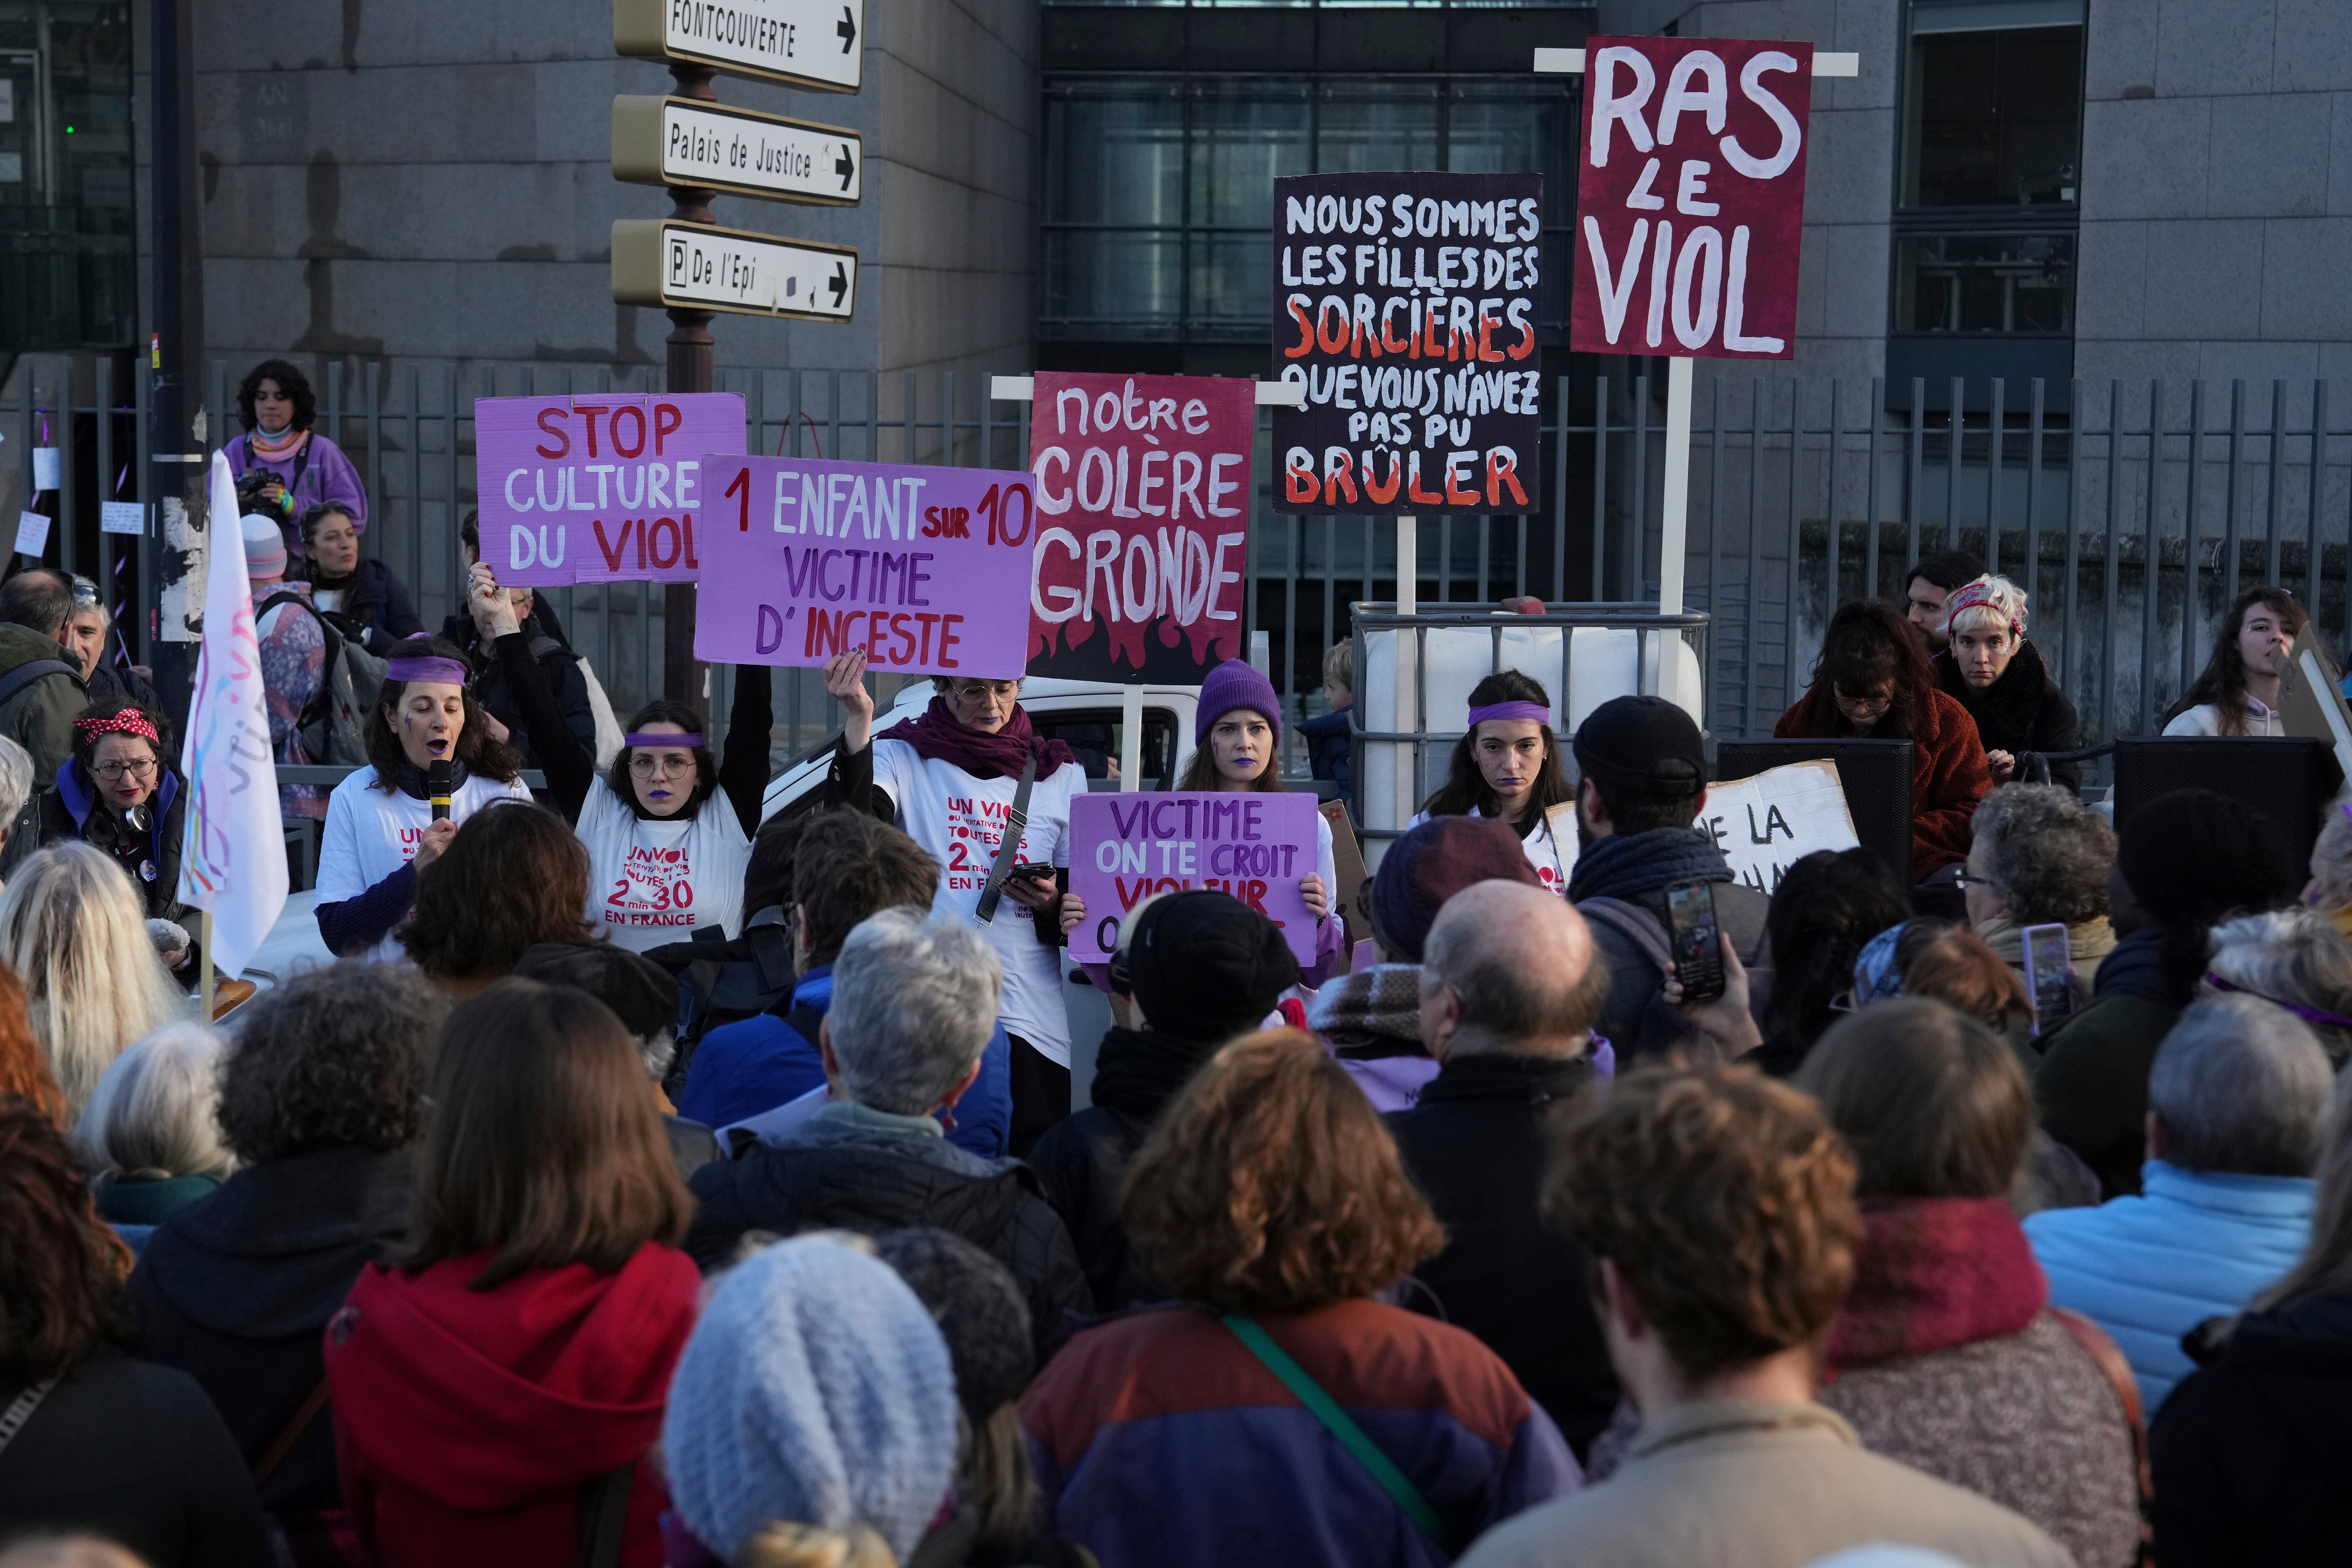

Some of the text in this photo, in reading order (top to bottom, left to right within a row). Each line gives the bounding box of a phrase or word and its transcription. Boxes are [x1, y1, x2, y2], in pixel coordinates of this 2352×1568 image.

[672, 0, 795, 58] FONTCOUVERTE
[1590, 46, 1801, 179] RAS
[670, 123, 811, 178] Palais de Justice
[1626, 158, 1720, 217] LE
[1287, 193, 1540, 243] NOUS SOMMES
[693, 249, 712, 283] De
[721, 253, 756, 298] l'Epi
[1282, 245, 1347, 286] LES
[1483, 246, 1539, 290] DES
[1583, 216, 1785, 354] VIOL
[1285, 287, 1535, 363] SORCIÈRES
[1281, 362, 1540, 417] QUE VOUS N'AVEZ
[535, 403, 682, 459] STOP
[1349, 411, 1471, 448] PAS PU
[505, 461, 700, 512] CULTURE
[1032, 433, 1243, 520] COLÈRE
[1286, 443, 1529, 506] BRÛLER
[725, 467, 1032, 547] 1 ENFANT SUR 10
[511, 514, 698, 573] DU VIOL
[784, 545, 934, 606] VICTIME
[1031, 525, 1244, 627] GRONDE
[948, 797, 1011, 821] UN VIO
[962, 817, 997, 828] TENTATIVE
[1110, 799, 1262, 841] VICTIME
[1746, 803, 1794, 844] LA
[948, 826, 1001, 845] TOUTES
[949, 842, 969, 871] 2
[972, 865, 990, 875] min
[1096, 840, 1298, 878] ON TE CROIT
[633, 863, 661, 873] TENTIVE
[949, 877, 972, 889] EN
[605, 909, 695, 926] EN FRANCE
[607, 879, 693, 910] 2 min 30
